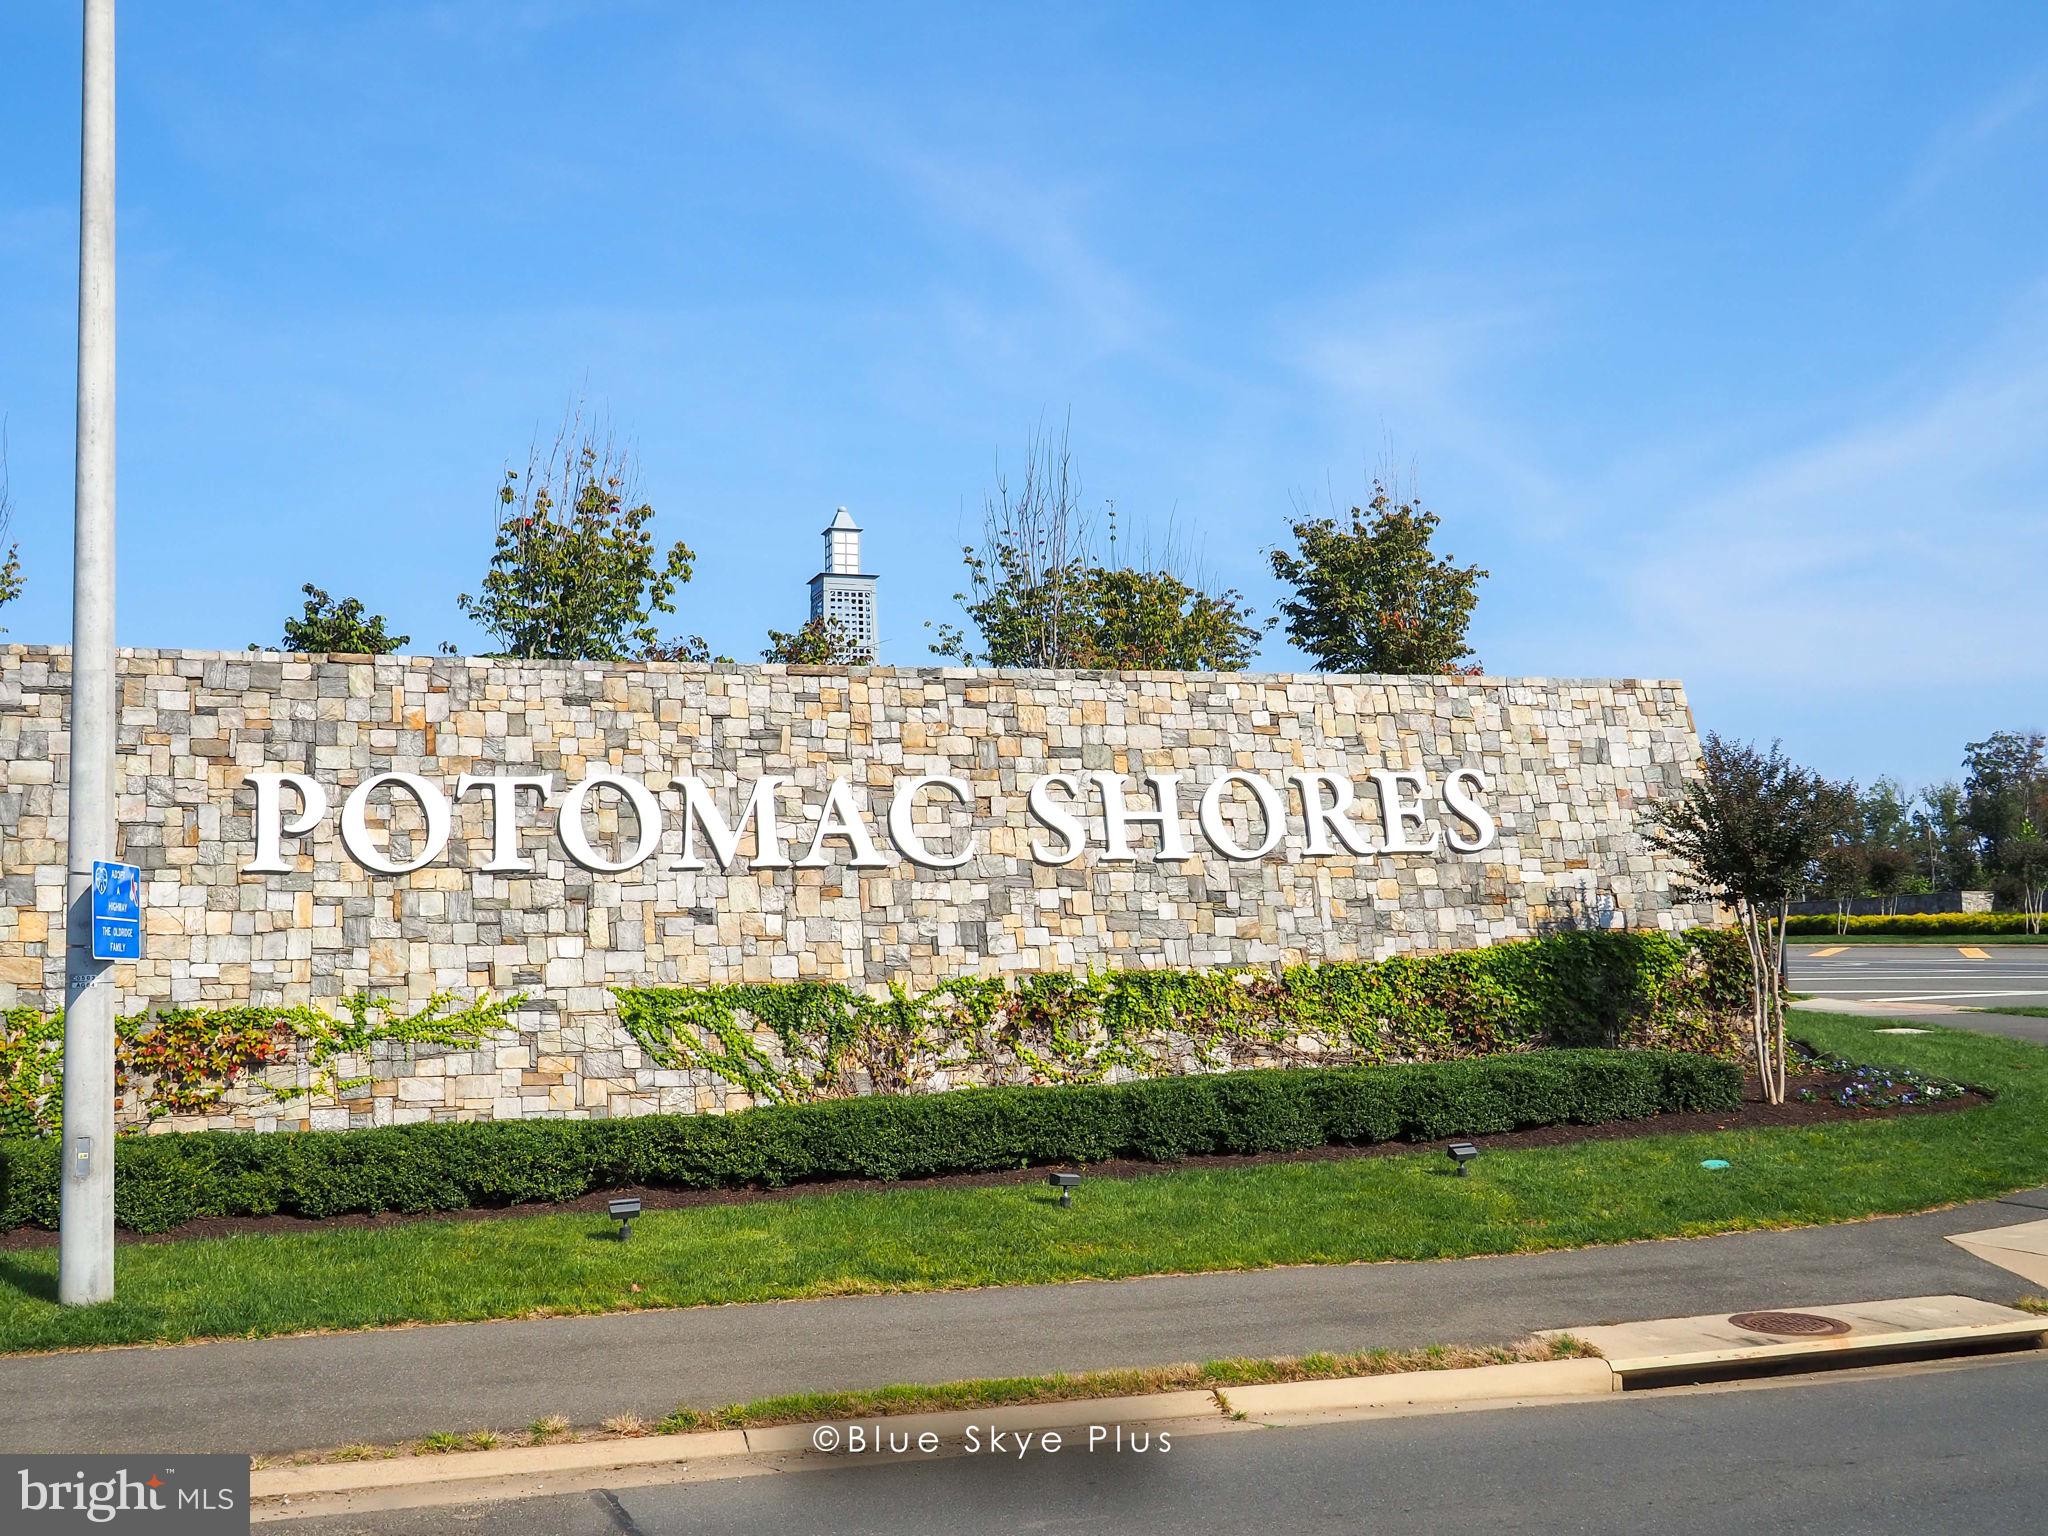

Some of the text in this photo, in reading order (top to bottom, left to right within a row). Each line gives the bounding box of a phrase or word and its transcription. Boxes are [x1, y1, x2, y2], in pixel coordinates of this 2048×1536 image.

[243, 768, 1496, 873] POTOMAC SHORES
[116, 886, 120, 896] A
[108, 901, 127, 912] HIGHWAY
[102, 926, 111, 936] THE
[110, 942, 126, 952] FAMILY
